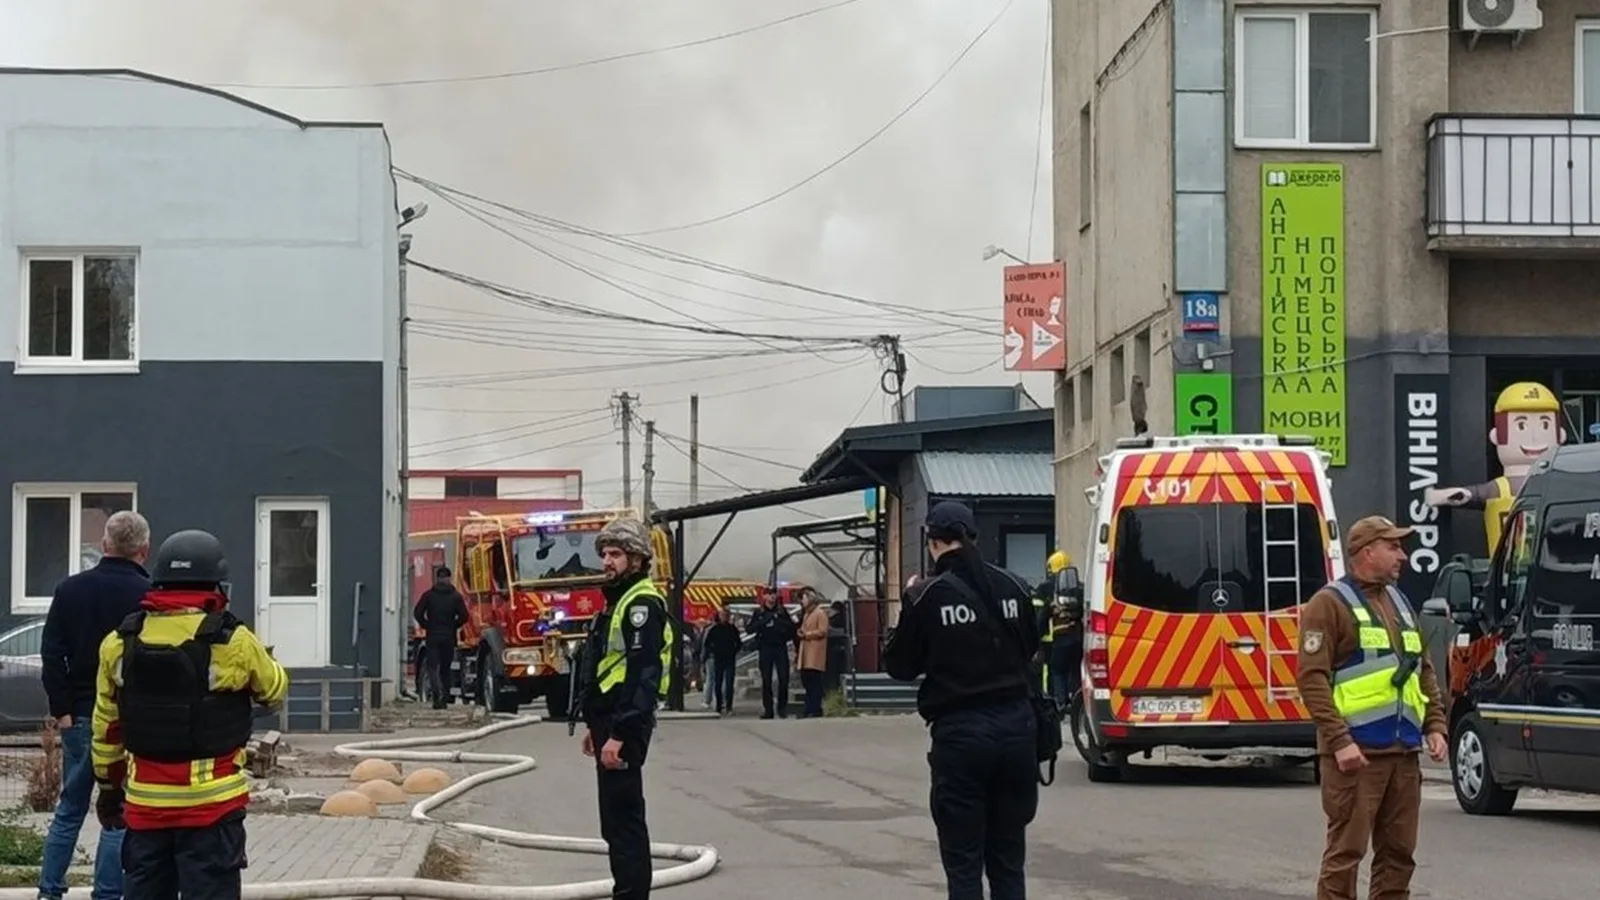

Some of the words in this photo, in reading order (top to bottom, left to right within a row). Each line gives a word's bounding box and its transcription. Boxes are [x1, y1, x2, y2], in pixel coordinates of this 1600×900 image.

[1185, 298, 1218, 318] 18а
[1270, 198, 1287, 393] АНГЛІЙСЬКА
[1294, 237, 1311, 393] НІМЕЦЬКА
[1319, 237, 1337, 393] ПОЛЬСЬКА
[1269, 411, 1340, 428] МОВИ
[1156, 479, 1190, 498] 101
[941, 598, 1019, 626] ПОІЯ
